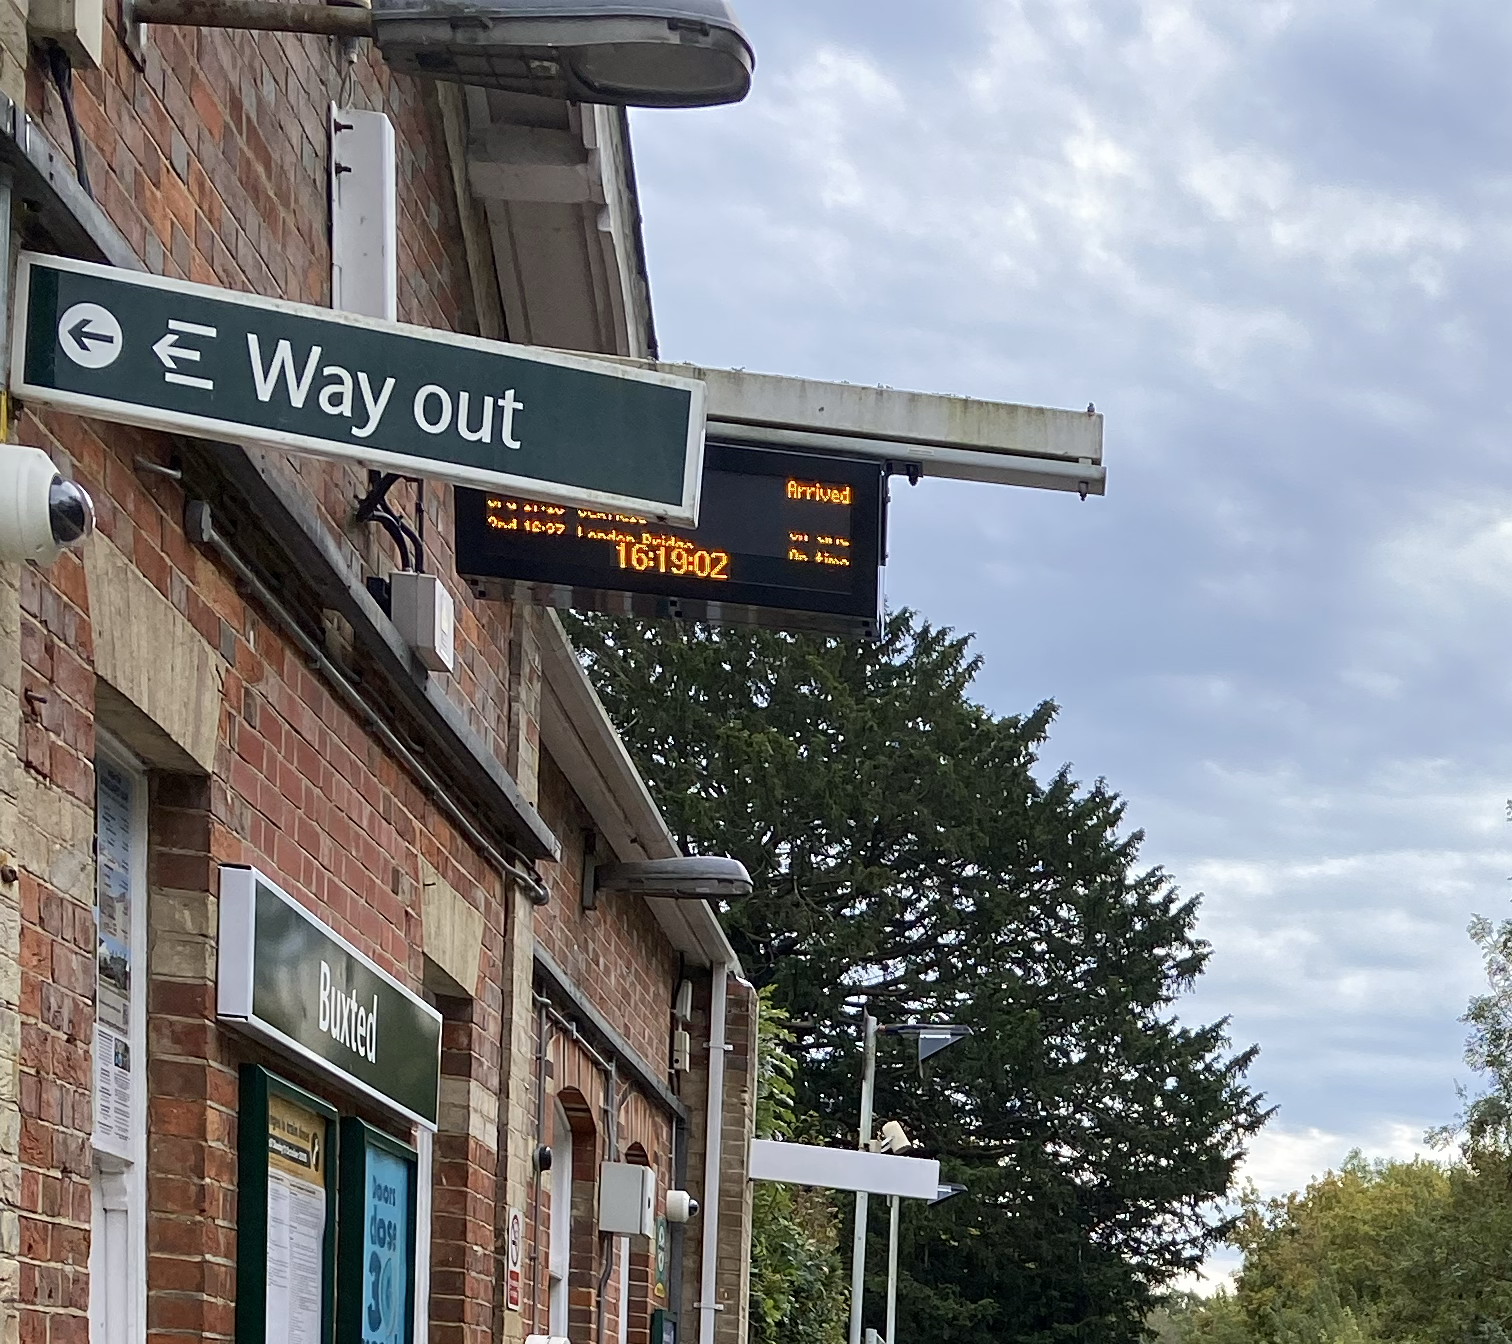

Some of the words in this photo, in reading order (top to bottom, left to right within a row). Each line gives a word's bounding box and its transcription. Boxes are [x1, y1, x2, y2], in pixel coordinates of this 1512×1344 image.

[247, 332, 396, 438] Way
[413, 384, 524, 449] out
[787, 480, 852, 505] Arrived
[616, 541, 729, 579] 16:19:02
[319, 960, 378, 1064] Buxted
